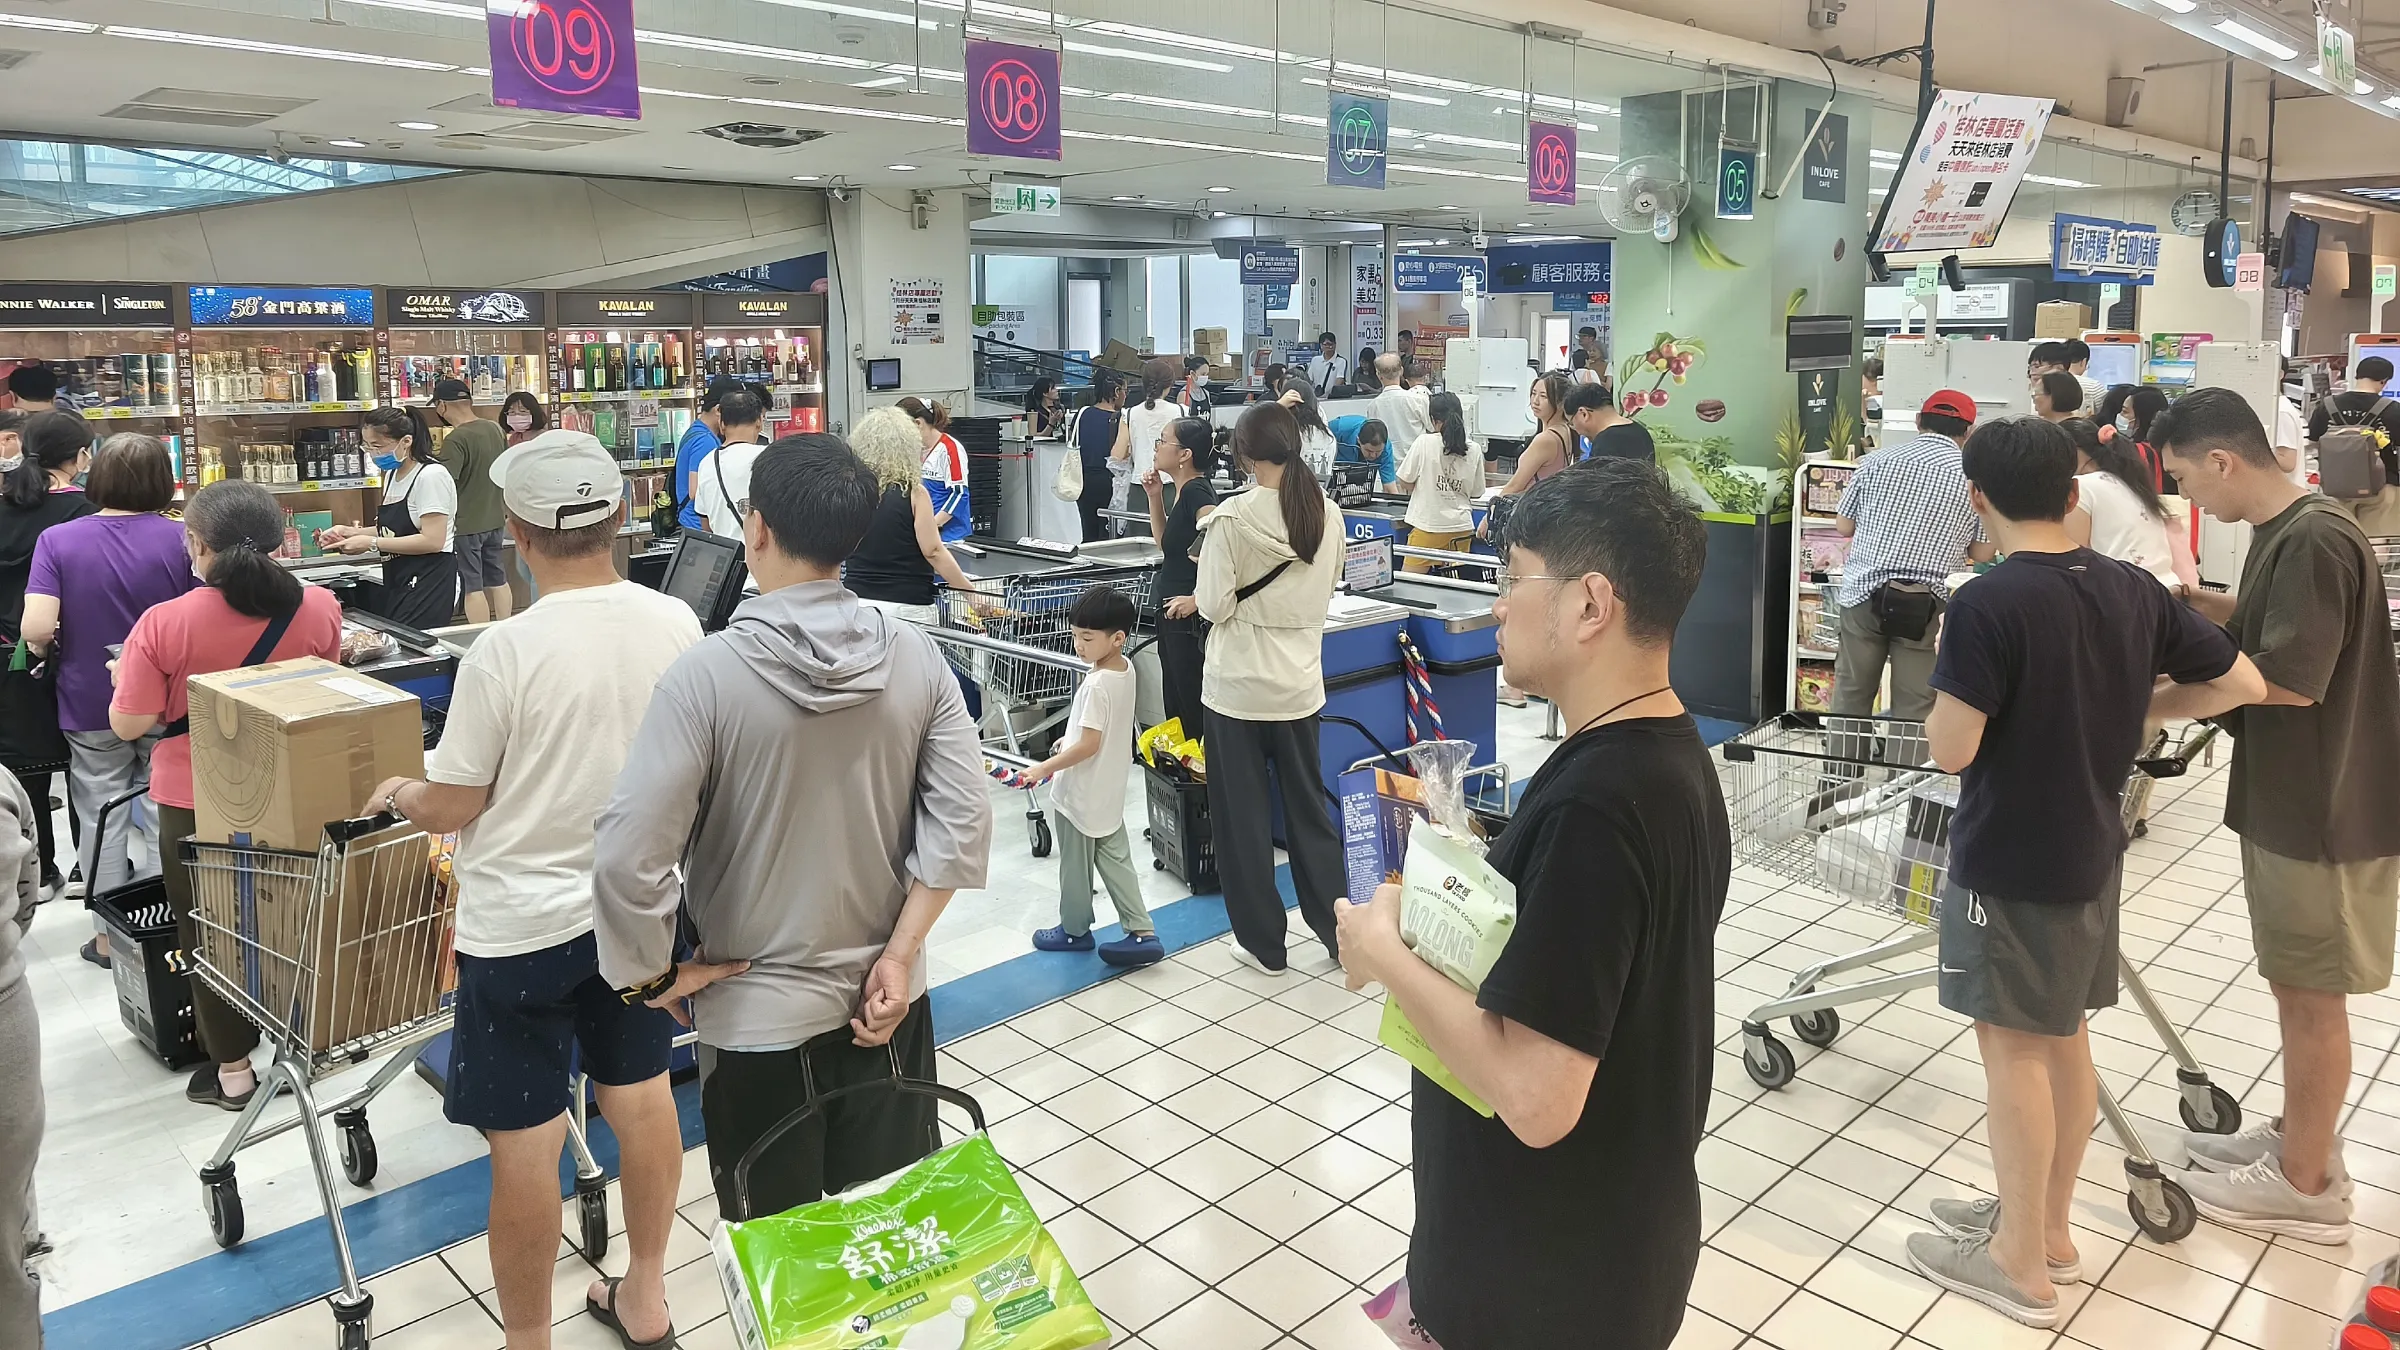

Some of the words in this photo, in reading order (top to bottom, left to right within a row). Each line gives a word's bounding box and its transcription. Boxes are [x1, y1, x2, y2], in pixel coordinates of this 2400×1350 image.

[525, 2, 601, 80] 09
[989, 71, 1038, 131] 08
[1953, 115, 2025, 139] 桂林店專屬活動
[1344, 118, 1371, 164] 07
[1947, 141, 2014, 158] 天天來桂林店消費
[1540, 143, 1565, 185] 06
[1811, 165, 1839, 179] INLOVE
[1727, 168, 1745, 201] 05
[1819, 180, 1831, 188] CAFE
[1532, 262, 1600, 282] 顧客服務
[2240, 271, 2258, 282] 08
[1918, 278, 1934, 288] 04
[2376, 278, 2392, 288] 07
[38, 299, 95, 310] WALKER
[113, 297, 166, 310] SINGLETON
[406, 295, 451, 306] OMAR
[599, 301, 654, 311] KAVALAN
[739, 301, 787, 311] KAVALAN
[1591, 294, 1609, 303] 422
[262, 300, 346, 315] 金門高粱酒
[978, 310, 1025, 322] 自助包裝區
[1355, 523, 1374, 539] 05
[1413, 885, 1442, 900] THOUSAND
[1442, 897, 1461, 914] LAYERS
[1461, 912, 1484, 938] COOKIES
[1407, 898, 1475, 970] OOLONG
[850, 1216, 907, 1242] Kleenex
[837, 1216, 951, 1280] 舒潔
